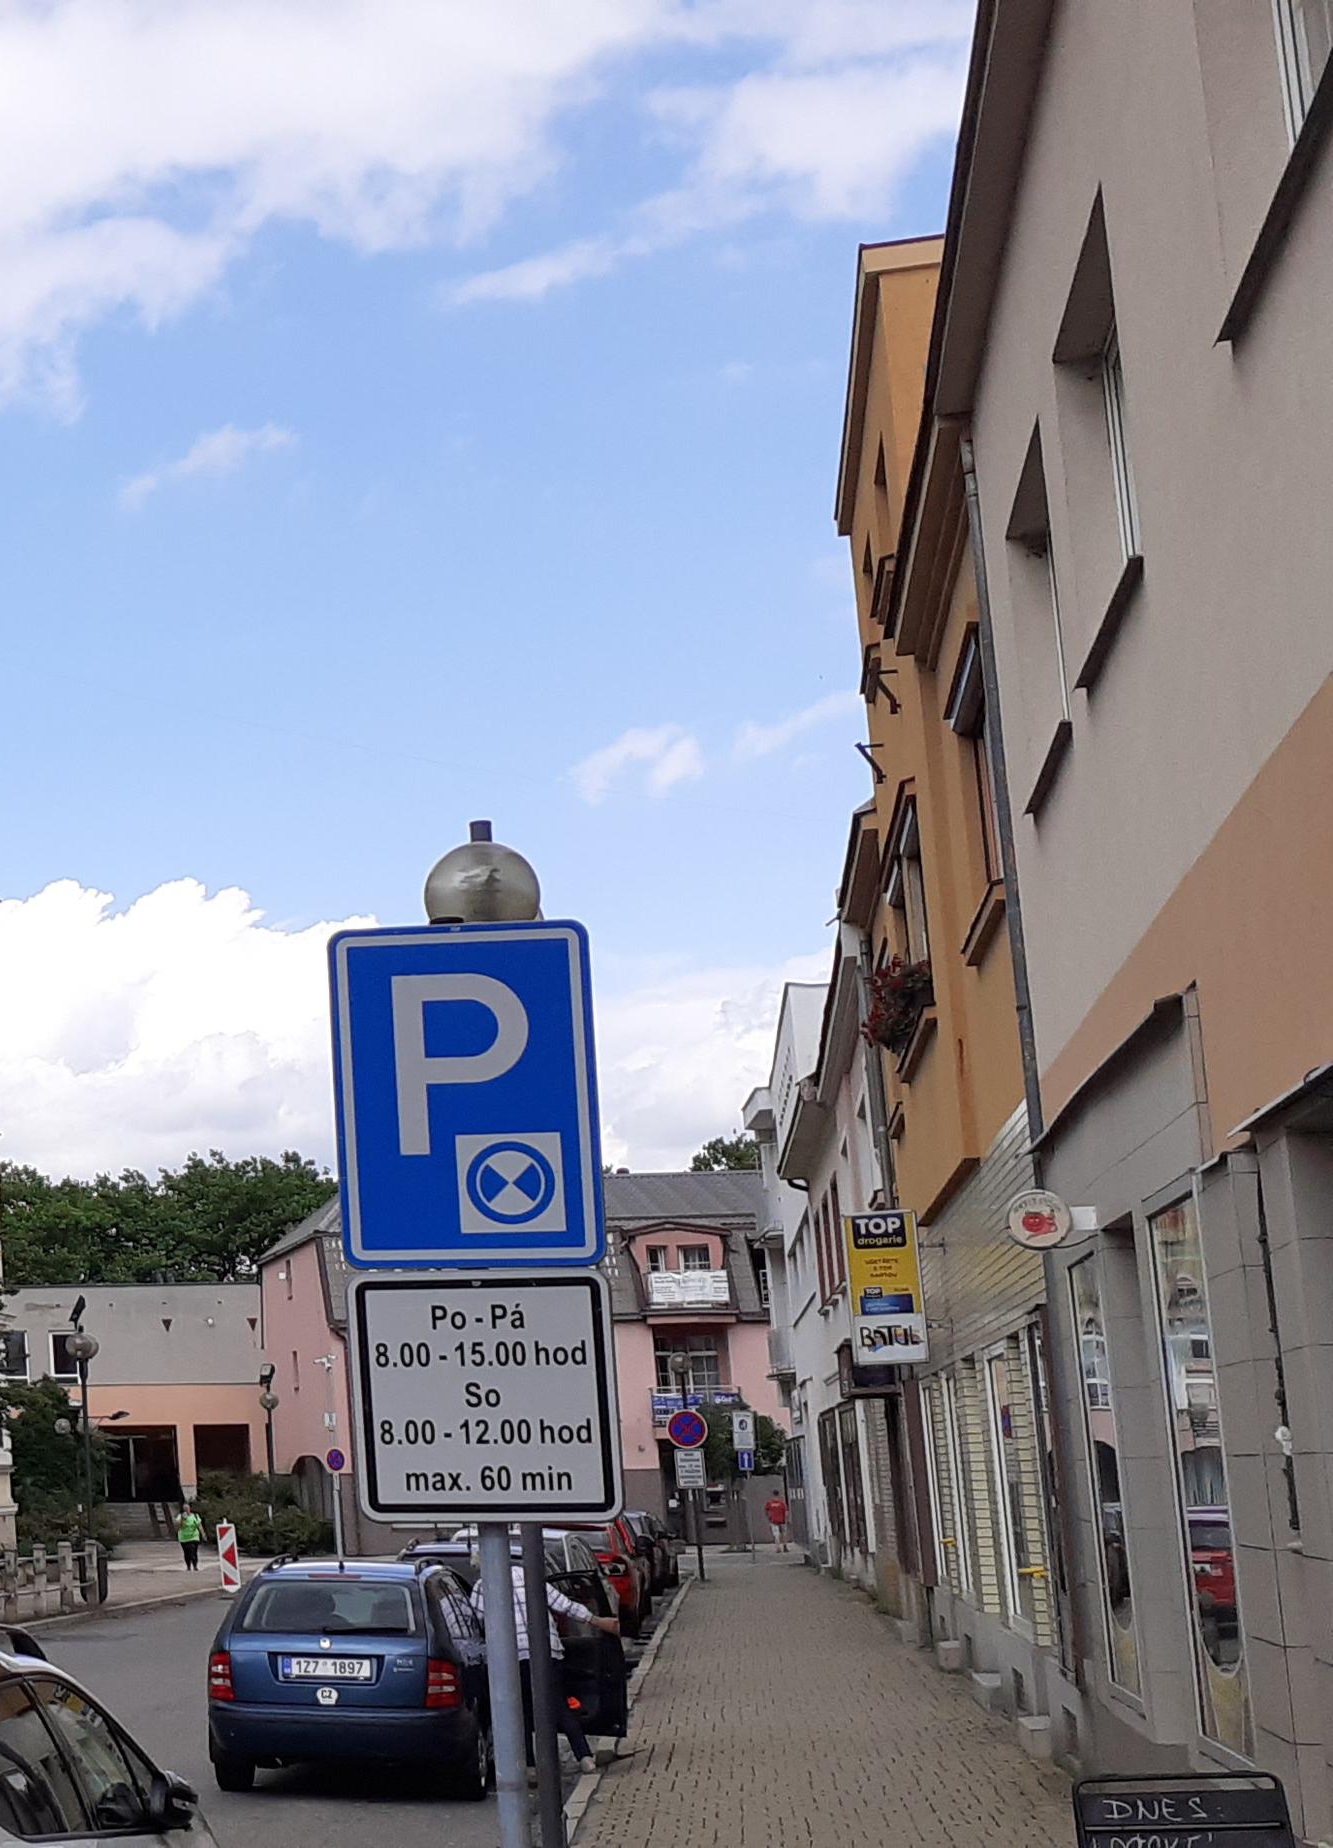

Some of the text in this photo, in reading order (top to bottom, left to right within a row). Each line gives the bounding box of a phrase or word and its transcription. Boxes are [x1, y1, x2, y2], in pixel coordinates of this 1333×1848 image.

[391, 973, 529, 1156] P
[855, 1217, 901, 1235] TOP
[430, 1304, 467, 1331] Po
[490, 1302, 526, 1330] Pá
[375, 1342, 431, 1368] 8.00
[454, 1340, 527, 1368] 15.00
[534, 1339, 588, 1366] hod
[464, 1381, 501, 1408] So
[380, 1419, 436, 1446] 8.00
[459, 1418, 532, 1445] 12.00
[539, 1417, 593, 1445] hod
[405, 1465, 573, 1492] max. 60 min
[295, 1660, 319, 1673] 1Z7
[332, 1661, 363, 1675] 1897
[320, 1689, 333, 1700] CZ
